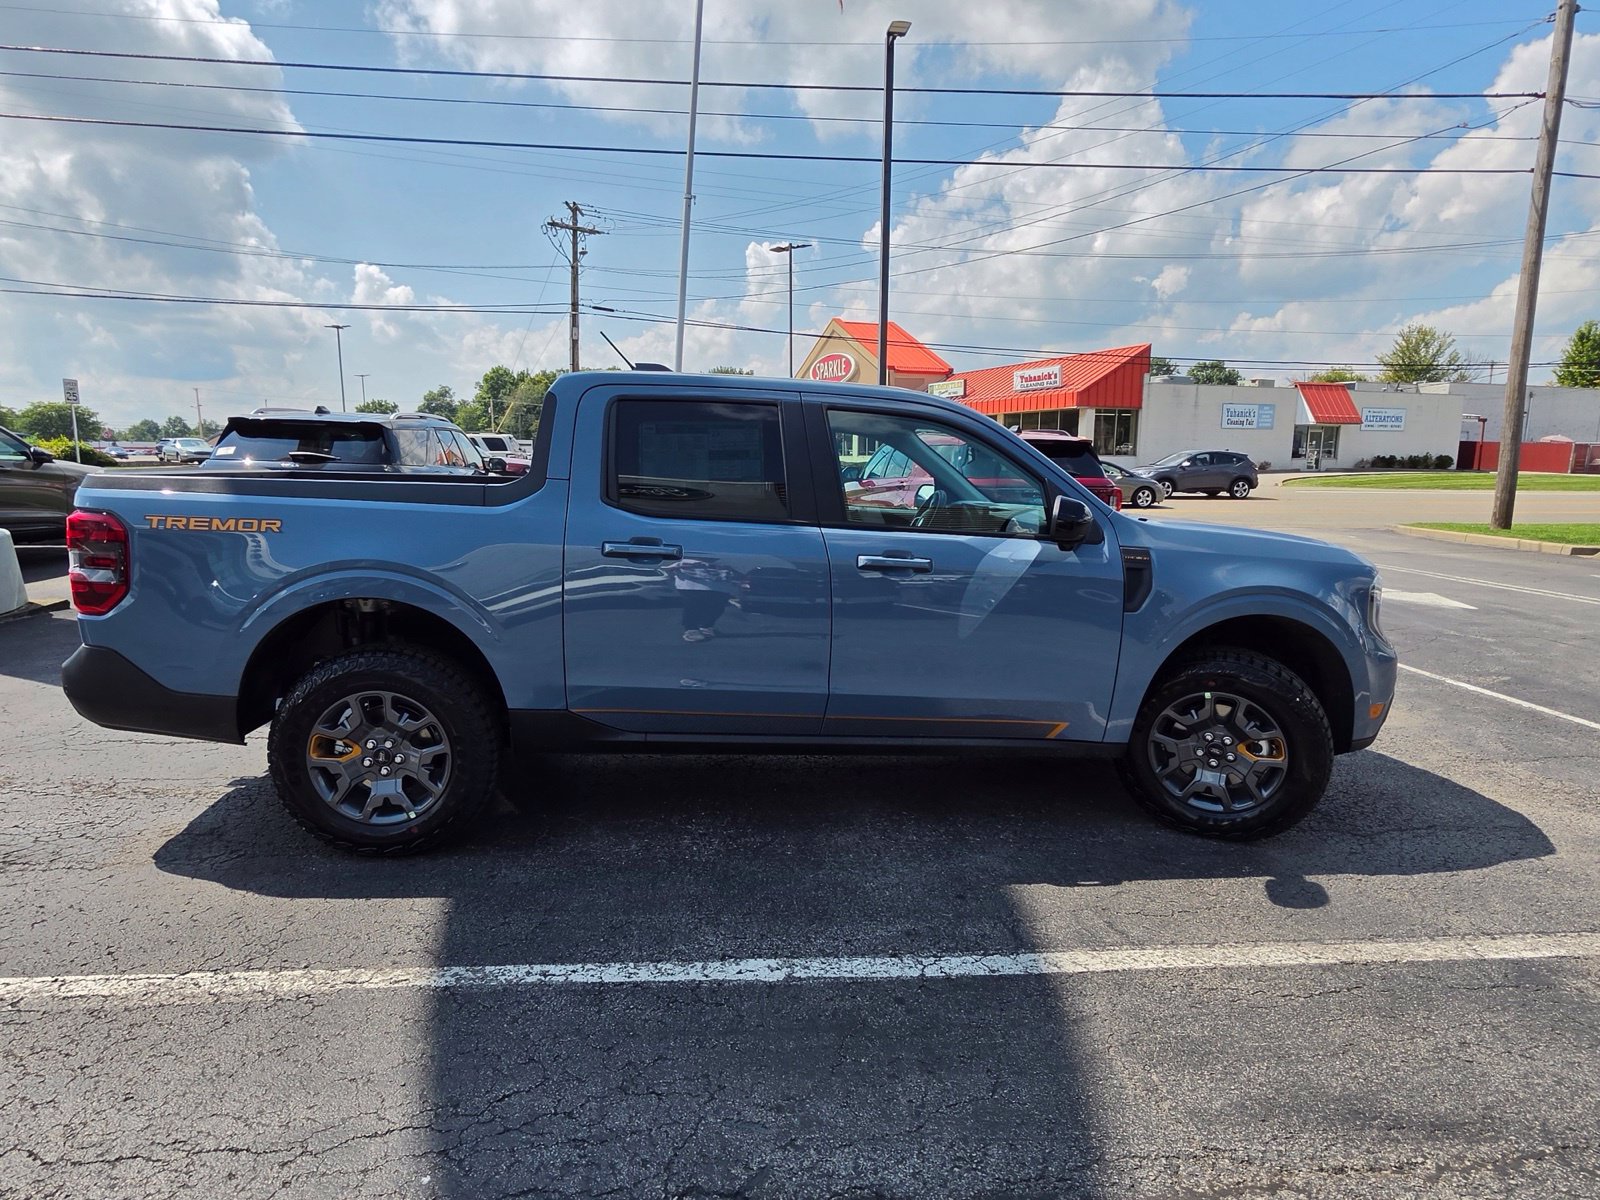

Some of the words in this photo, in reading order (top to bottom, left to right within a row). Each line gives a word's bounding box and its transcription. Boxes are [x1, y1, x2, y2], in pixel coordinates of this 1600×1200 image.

[815, 357, 847, 380] SPARKLE
[1019, 371, 1058, 383] Yuhanick's
[66, 391, 78, 402] 25
[1226, 407, 1256, 418] Yuhanick's
[1226, 418, 1245, 427] Cleaning
[1245, 418, 1255, 426] Fair
[1364, 414, 1403, 423] ALTERATIONS
[144, 513, 282, 533] TREMOR
